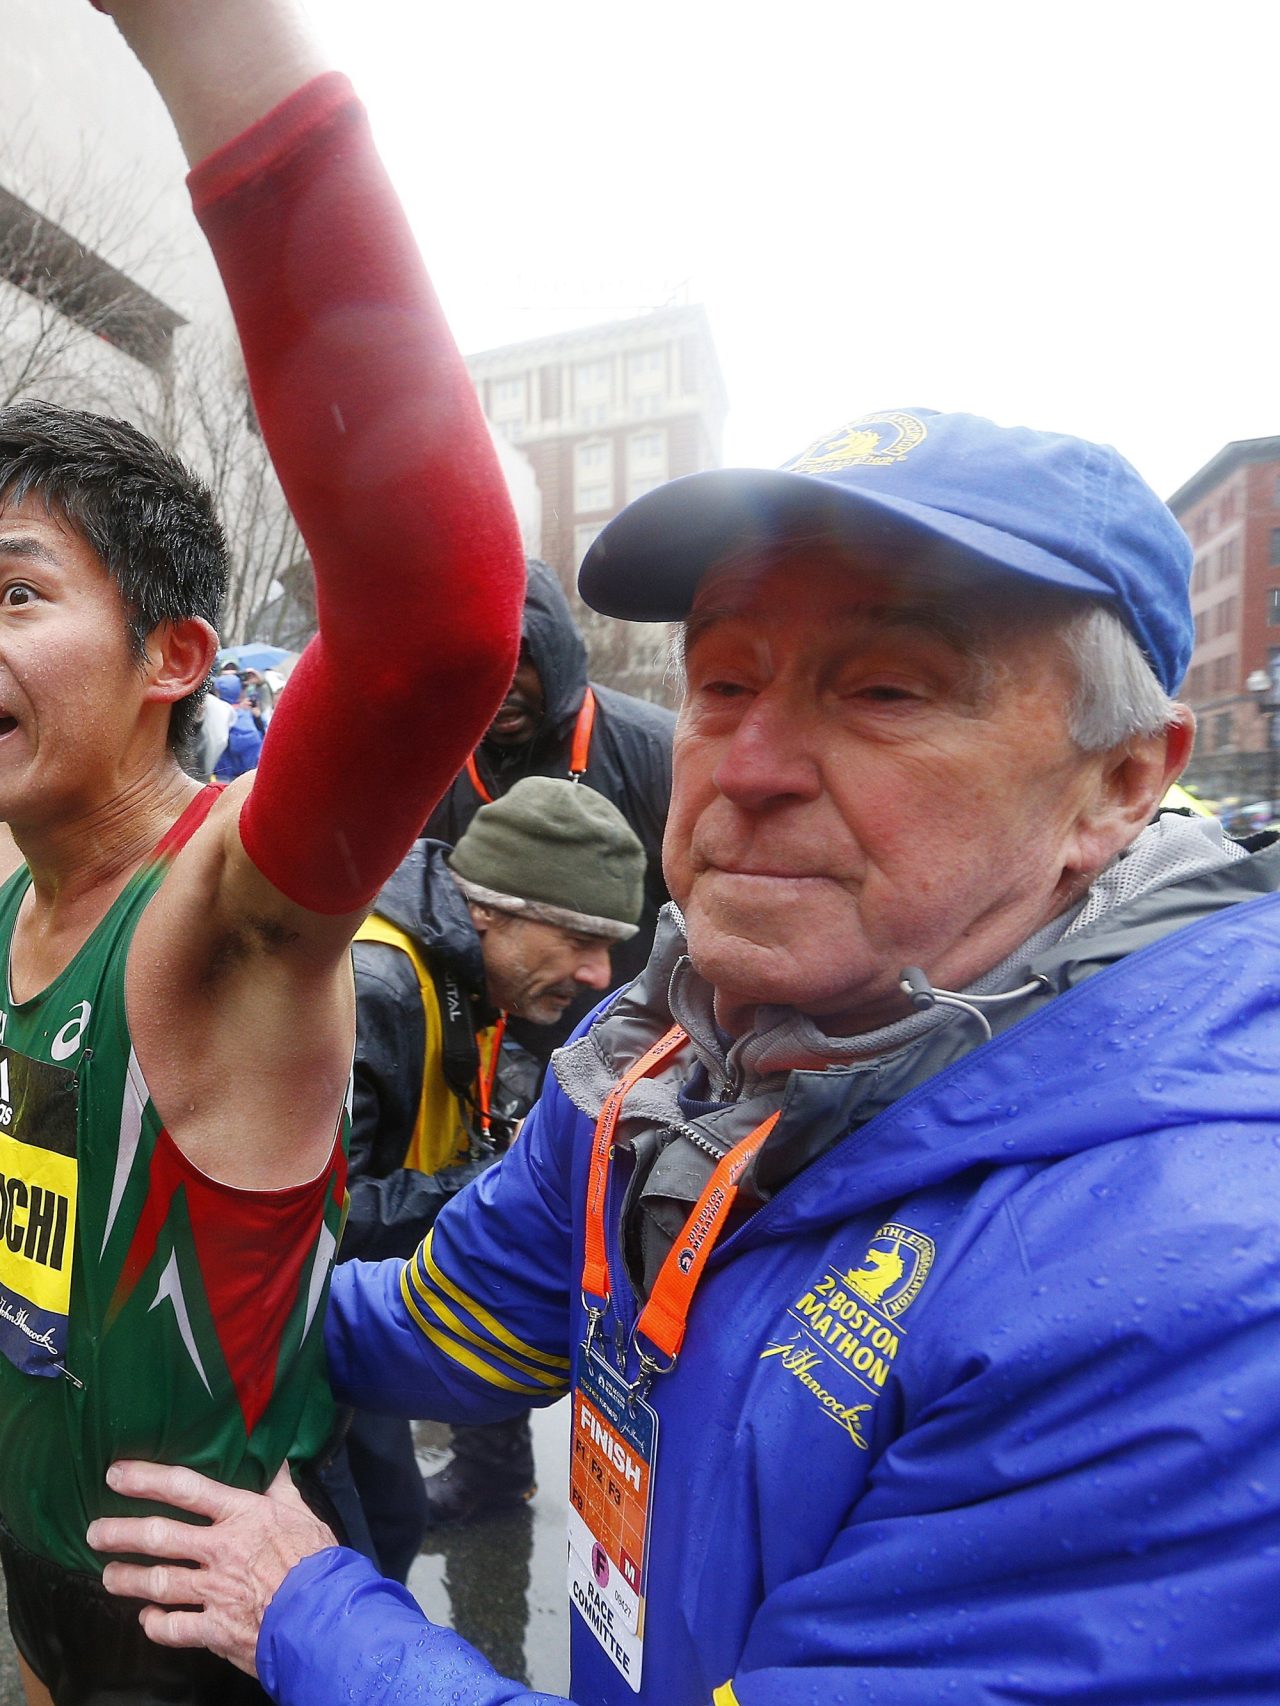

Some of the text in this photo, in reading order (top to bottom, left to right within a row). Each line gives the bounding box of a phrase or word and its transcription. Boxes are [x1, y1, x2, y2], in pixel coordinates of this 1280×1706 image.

[692, 1192, 724, 1252] MARATHON
[699, 1187, 721, 1223] BOSTON
[14, 1307, 59, 1355] Hancock
[827, 1291, 900, 1361] BOSTON
[575, 1438, 586, 1461] F1
[580, 1403, 641, 1493] FINISH
[591, 1458, 604, 1484] F2
[572, 1487, 583, 1511] F9
[608, 1480, 621, 1506] F3
[596, 1549, 607, 1577] F
[624, 1558, 636, 1585] M
[587, 1580, 615, 1631] RACE
[573, 1580, 630, 1676] COMMITTEE
